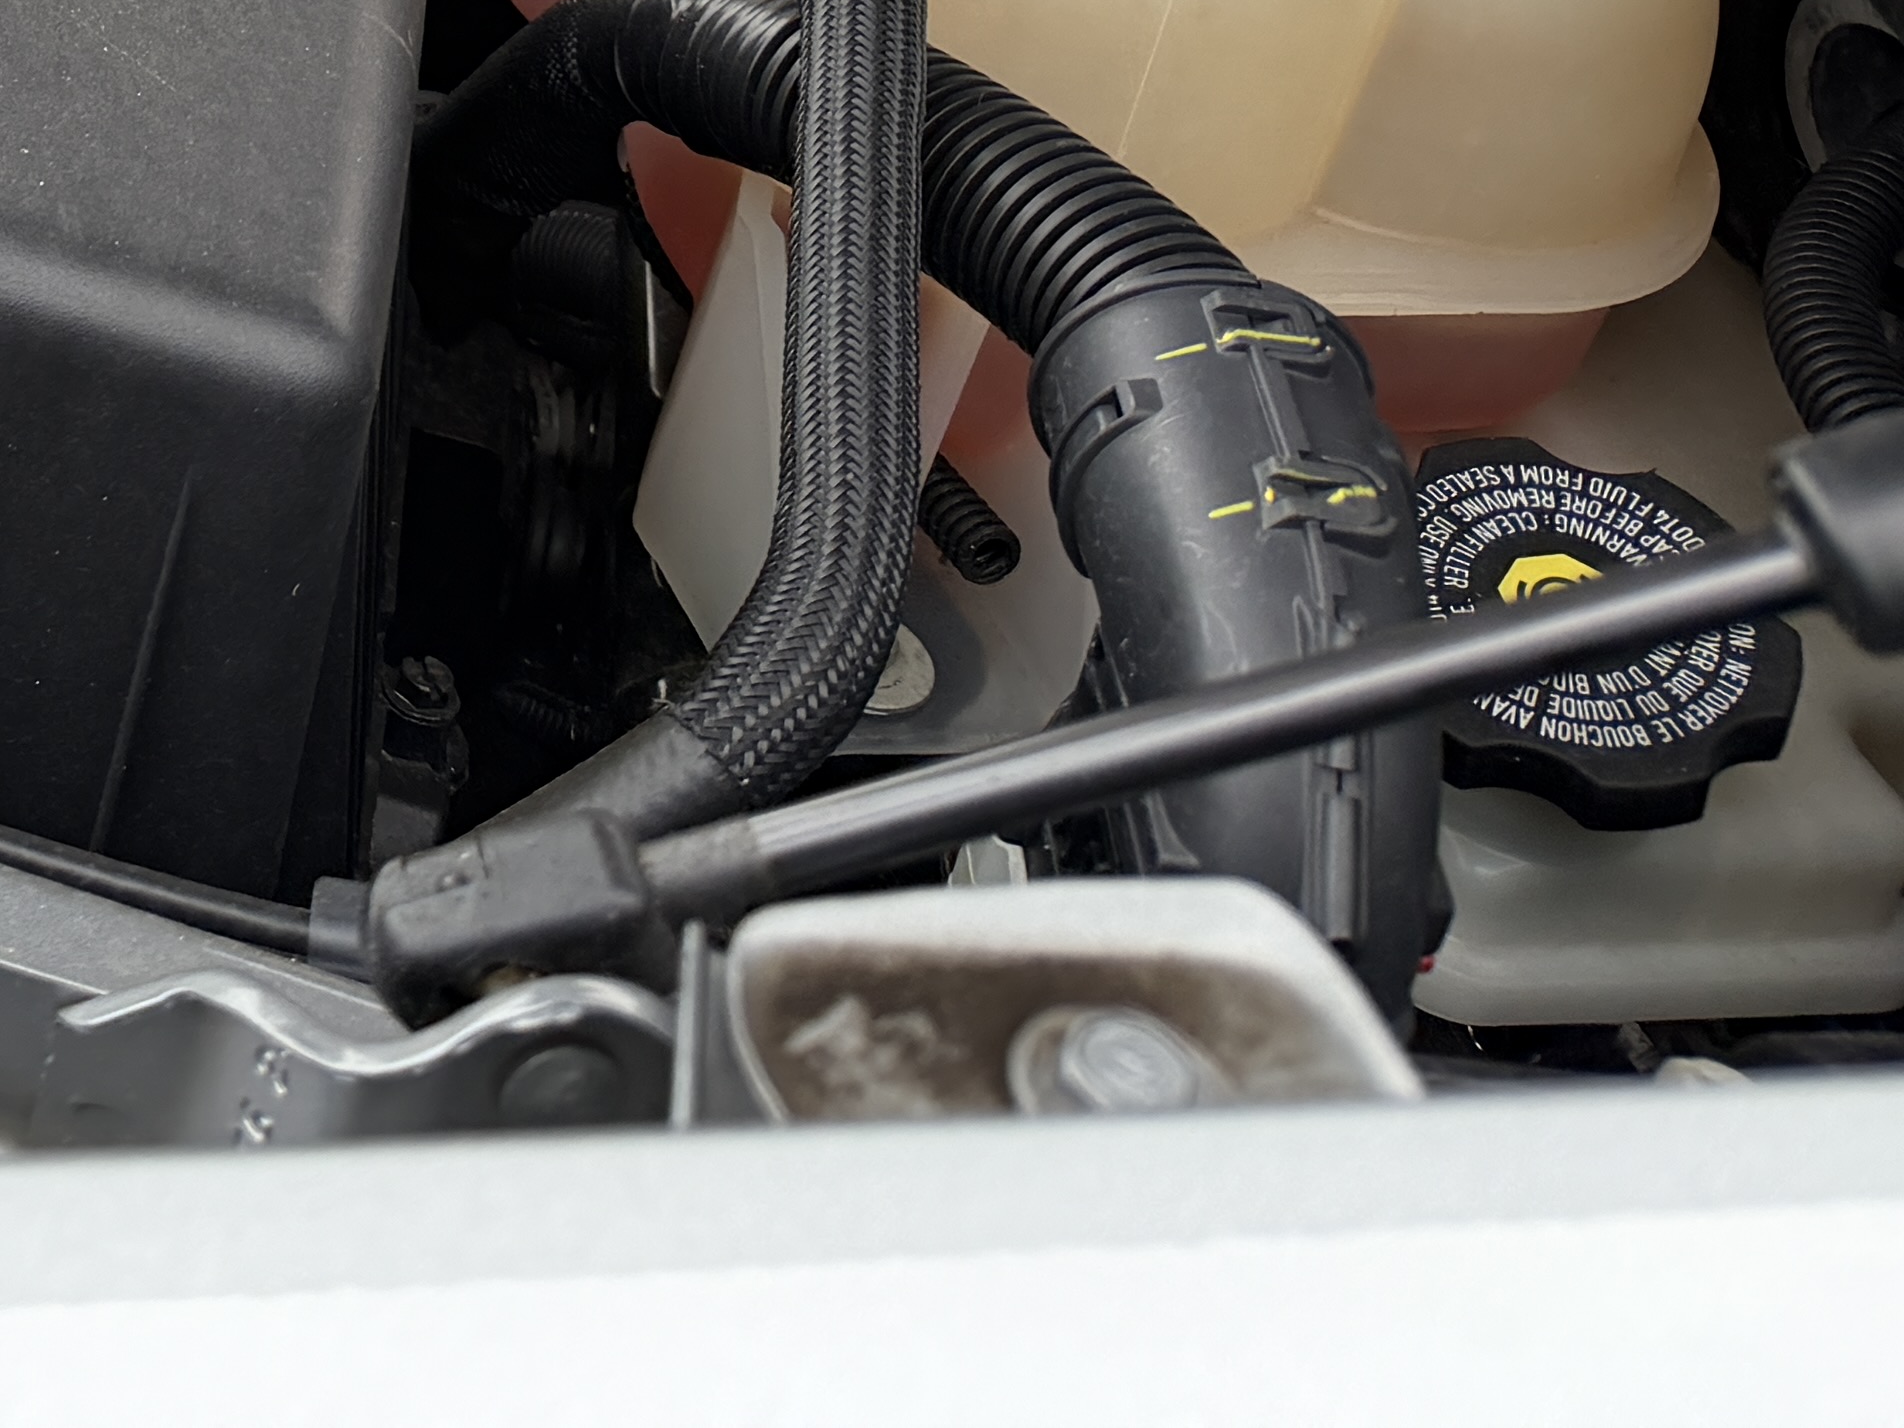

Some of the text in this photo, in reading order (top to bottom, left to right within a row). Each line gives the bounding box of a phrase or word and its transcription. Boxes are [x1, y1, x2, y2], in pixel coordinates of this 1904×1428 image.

[1425, 465, 1501, 502] SEALED
[1499, 464, 1515, 485] A
[1520, 464, 1584, 491] FROM
[1589, 477, 1654, 517] FLUID
[1471, 510, 1538, 544] CLEAN
[1561, 491, 1644, 537] BEFORE
[1420, 515, 1458, 548] USE
[1443, 533, 1485, 589] FILLER
[1596, 665, 1652, 695] D'UN
[1662, 668, 1705, 703] QUE
[1677, 656, 1753, 731] NETTOYER
[1546, 693, 1635, 721] LIQUIDE
[1635, 690, 1670, 716] DU
[1539, 715, 1652, 748] BOUCHON
[1650, 716, 1686, 743] LE
